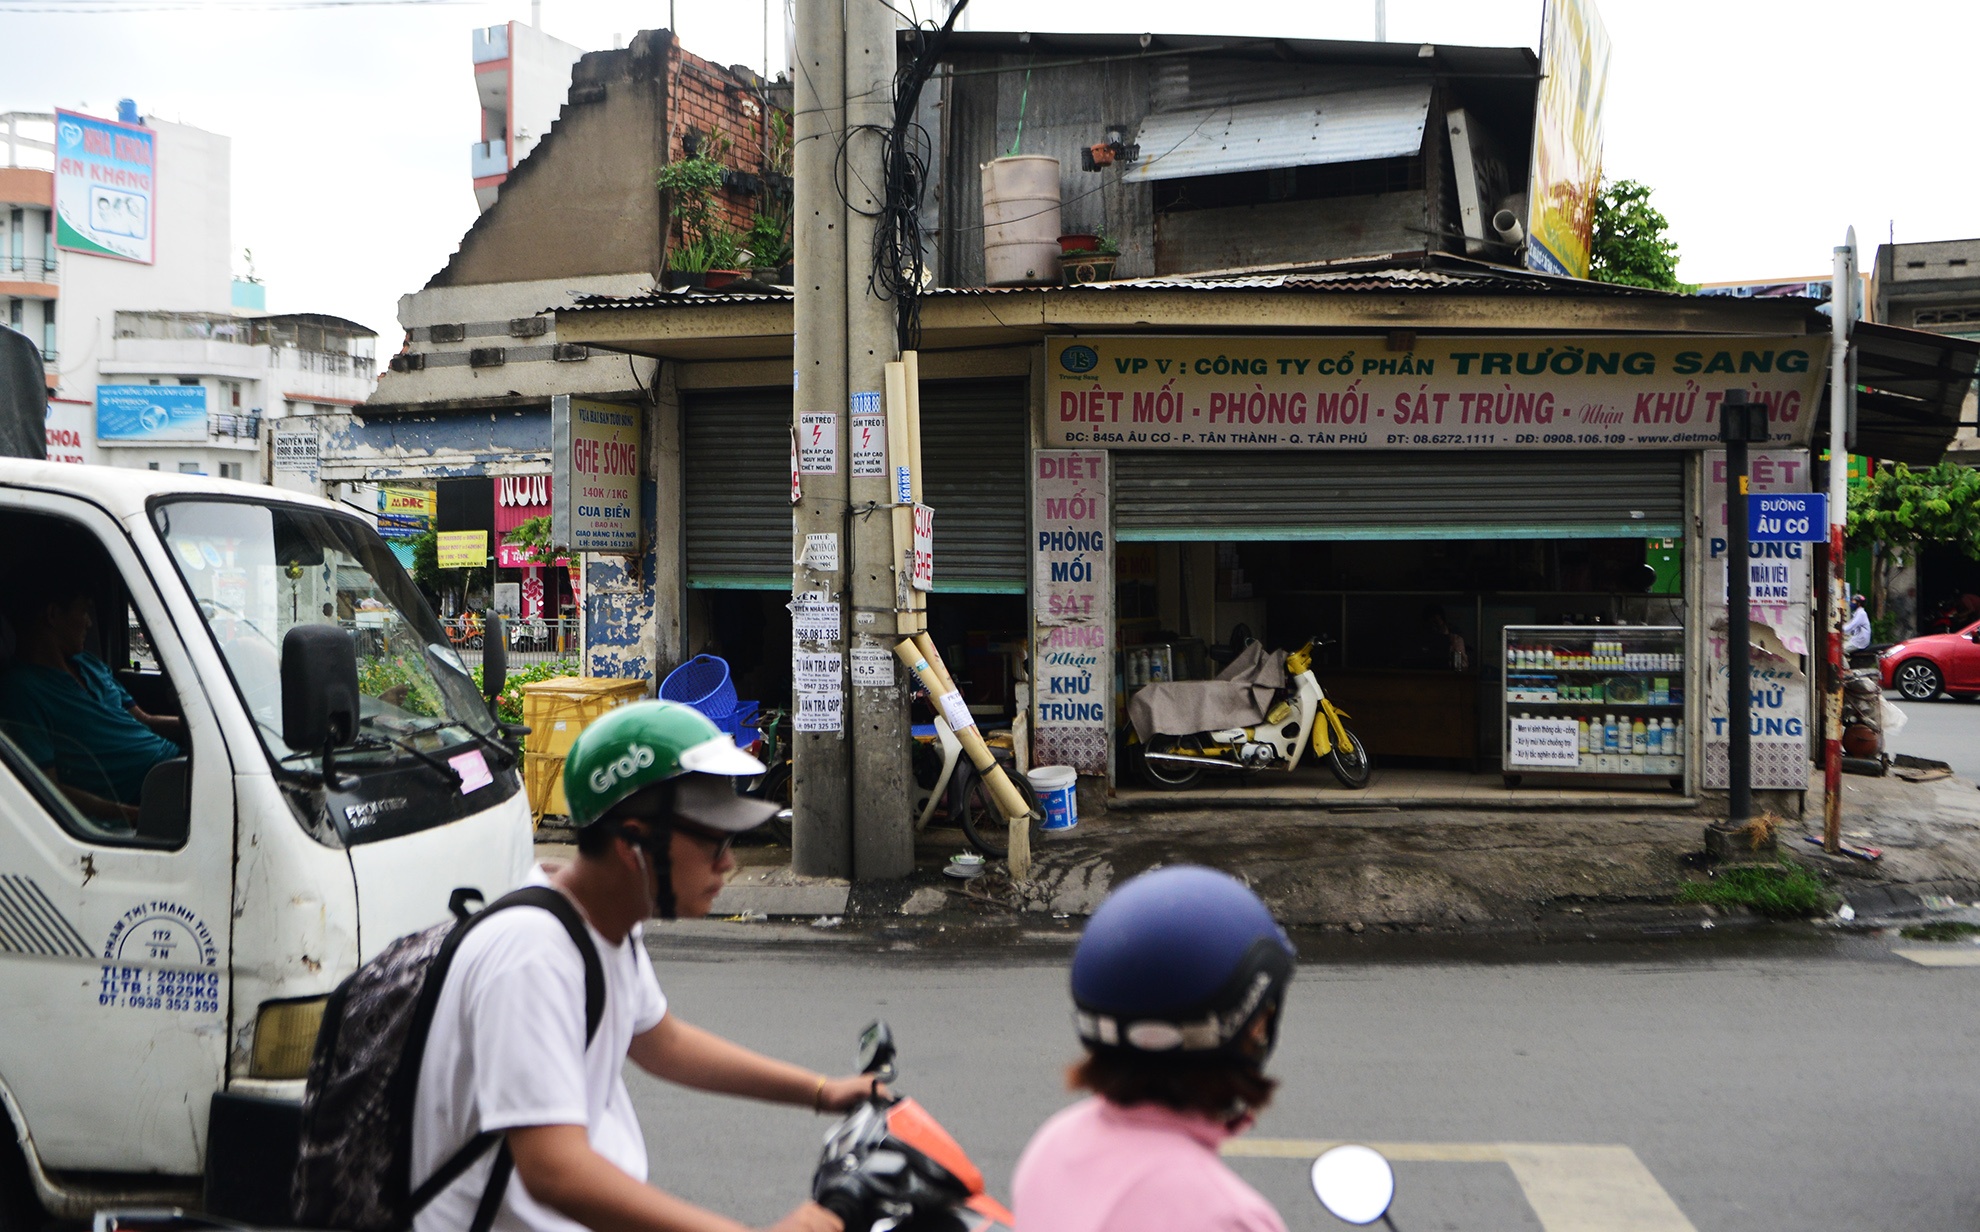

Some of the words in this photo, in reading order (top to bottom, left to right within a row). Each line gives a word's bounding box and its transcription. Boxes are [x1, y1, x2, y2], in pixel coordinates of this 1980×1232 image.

[115, 134, 150, 166] KHOA
[60, 158, 83, 177] AN
[90, 163, 150, 190] KHANG
[1115, 358, 1148, 374] VP
[1155, 359, 1172, 374] V
[1194, 354, 1268, 375] CÔNG
[1276, 358, 1311, 375] TY
[1318, 351, 1355, 375] CỔ
[1362, 351, 1435, 375] PHẦN
[1450, 346, 1656, 375] TRƯỜNG
[1672, 350, 1809, 375] SANG
[1060, 383, 1124, 432] DIỆT
[1133, 378, 1184, 423] MỐI
[1209, 383, 1307, 424] PHÒNG
[1316, 379, 1369, 424] MỐI
[1393, 384, 1450, 424] SÁT
[1459, 383, 1555, 424] TRÙNG
[1578, 403, 1624, 429] Nhận
[1633, 379, 1700, 424] KHỬ
[1065, 432, 1089, 442] ĐC:
[1093, 433, 1124, 442] 845A
[1128, 431, 1146, 442] ÂU
[1151, 432, 1171, 442] CƠ
[1183, 434, 1194, 442] P.
[1199, 431, 1226, 443] TÂN
[1230, 431, 1277, 443] THÀNH
[1290, 434, 1303, 444] Q.
[1308, 432, 1335, 443] TÂN
[1340, 432, 1368, 443] PHÚ
[1387, 434, 1409, 443] ĐT:
[1413, 434, 1494, 444] 08.6272.1111
[1515, 434, 1539, 444] DĐ:
[1543, 434, 1625, 444] 0908.106.109
[574, 438, 599, 482] GHẸ
[604, 430, 636, 476] SỐNG
[1039, 452, 1102, 485] DIỆT
[402, 498, 424, 508] DRC
[583, 487, 604, 498] 140K
[1046, 488, 1096, 519] MỐI
[578, 505, 600, 517] CUA
[604, 503, 631, 518] BIỂN
[1761, 498, 1806, 512] ĐƯỜNG
[914, 508, 932, 539] CUA
[1757, 514, 1781, 534] ÂU
[1785, 516, 1810, 534] CƠ
[1039, 526, 1103, 551] PHÒNG
[1051, 553, 1092, 582] MỐI
[1049, 589, 1094, 615] SÁT
[1756, 584, 1788, 597] HÀNG
[859, 666, 874, 675] 6,5
[1045, 652, 1097, 668] Nhận
[1050, 670, 1092, 694] KHỬ
[1039, 698, 1104, 721] TRÙNG
[1712, 712, 1803, 736] TÙNG
[589, 743, 655, 794] Grab
[150, 901, 195, 923] THANH
[101, 965, 143, 981] TLBT
[157, 969, 219, 986] 2030KG
[156, 984, 218, 1000] 3625KG
[129, 996, 161, 1009] 0938
[166, 999, 189, 1011] 353
[194, 1000, 218, 1013] 359
